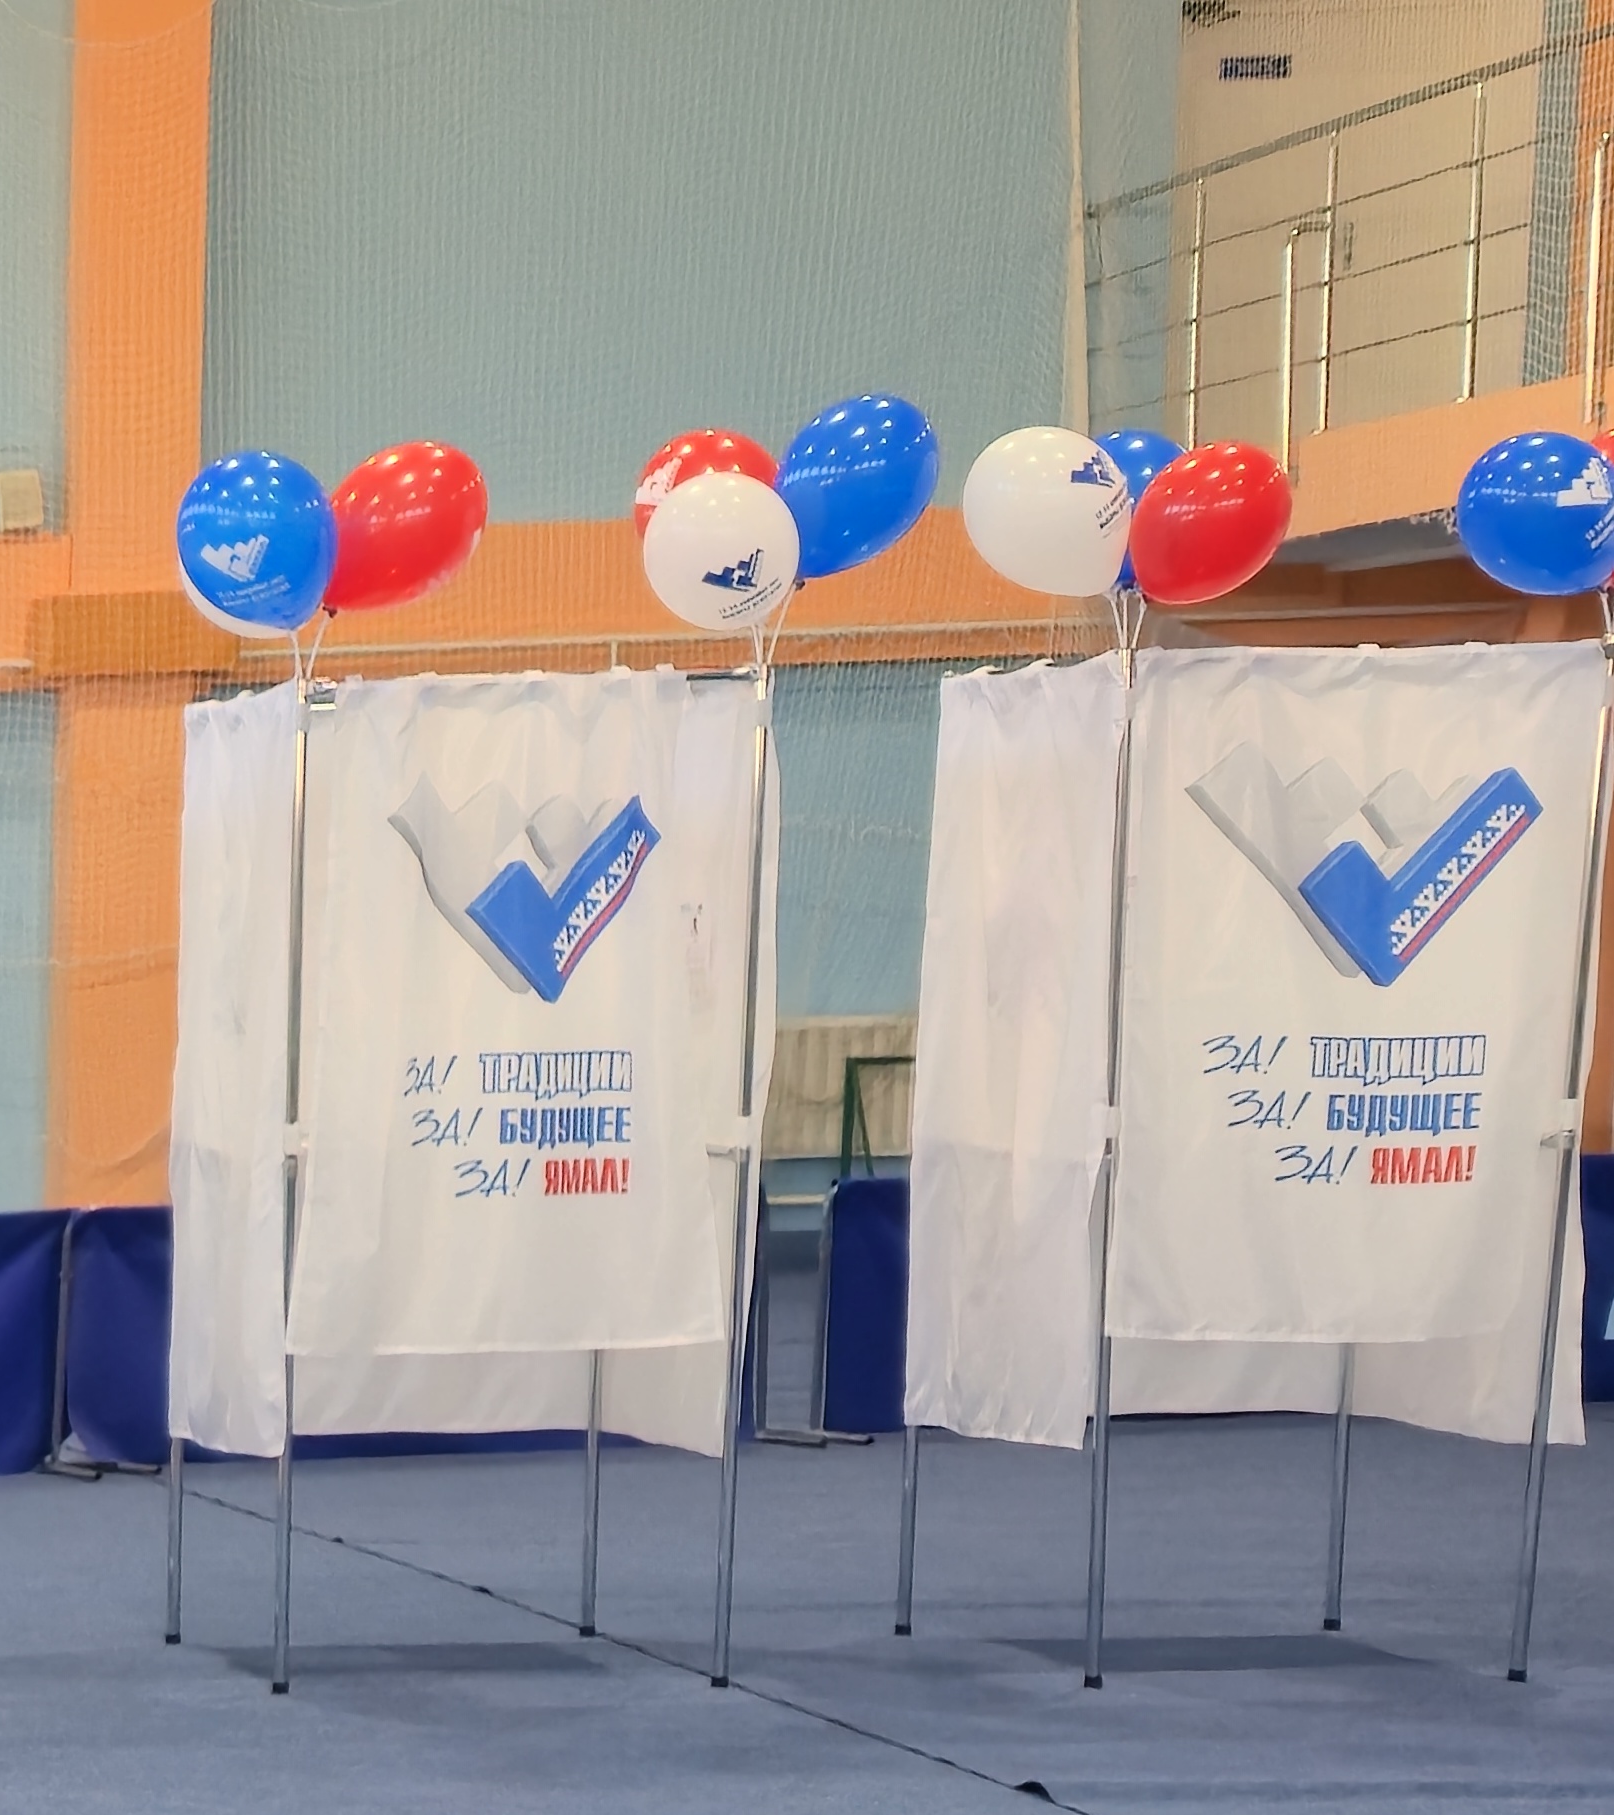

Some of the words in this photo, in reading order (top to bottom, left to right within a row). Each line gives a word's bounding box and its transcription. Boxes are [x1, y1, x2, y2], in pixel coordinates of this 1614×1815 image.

[404, 1054, 457, 1097] ЗА!
[479, 1050, 633, 1101] ТРАДИЦИИ
[1202, 1034, 1287, 1074] ЗА!
[1310, 1034, 1486, 1084] ТРАДИЦИИ
[412, 1107, 482, 1148] ЗА!
[498, 1105, 632, 1149] БУДУЩЕЕ
[1227, 1089, 1311, 1131] ЗА!
[1326, 1091, 1482, 1136] БУДУЩЕЕ
[454, 1158, 530, 1199] ЗА!
[544, 1155, 630, 1197] ЯМАЛ!
[1274, 1144, 1359, 1186] ЗА!
[1369, 1144, 1476, 1186] ЯМАЛ!
